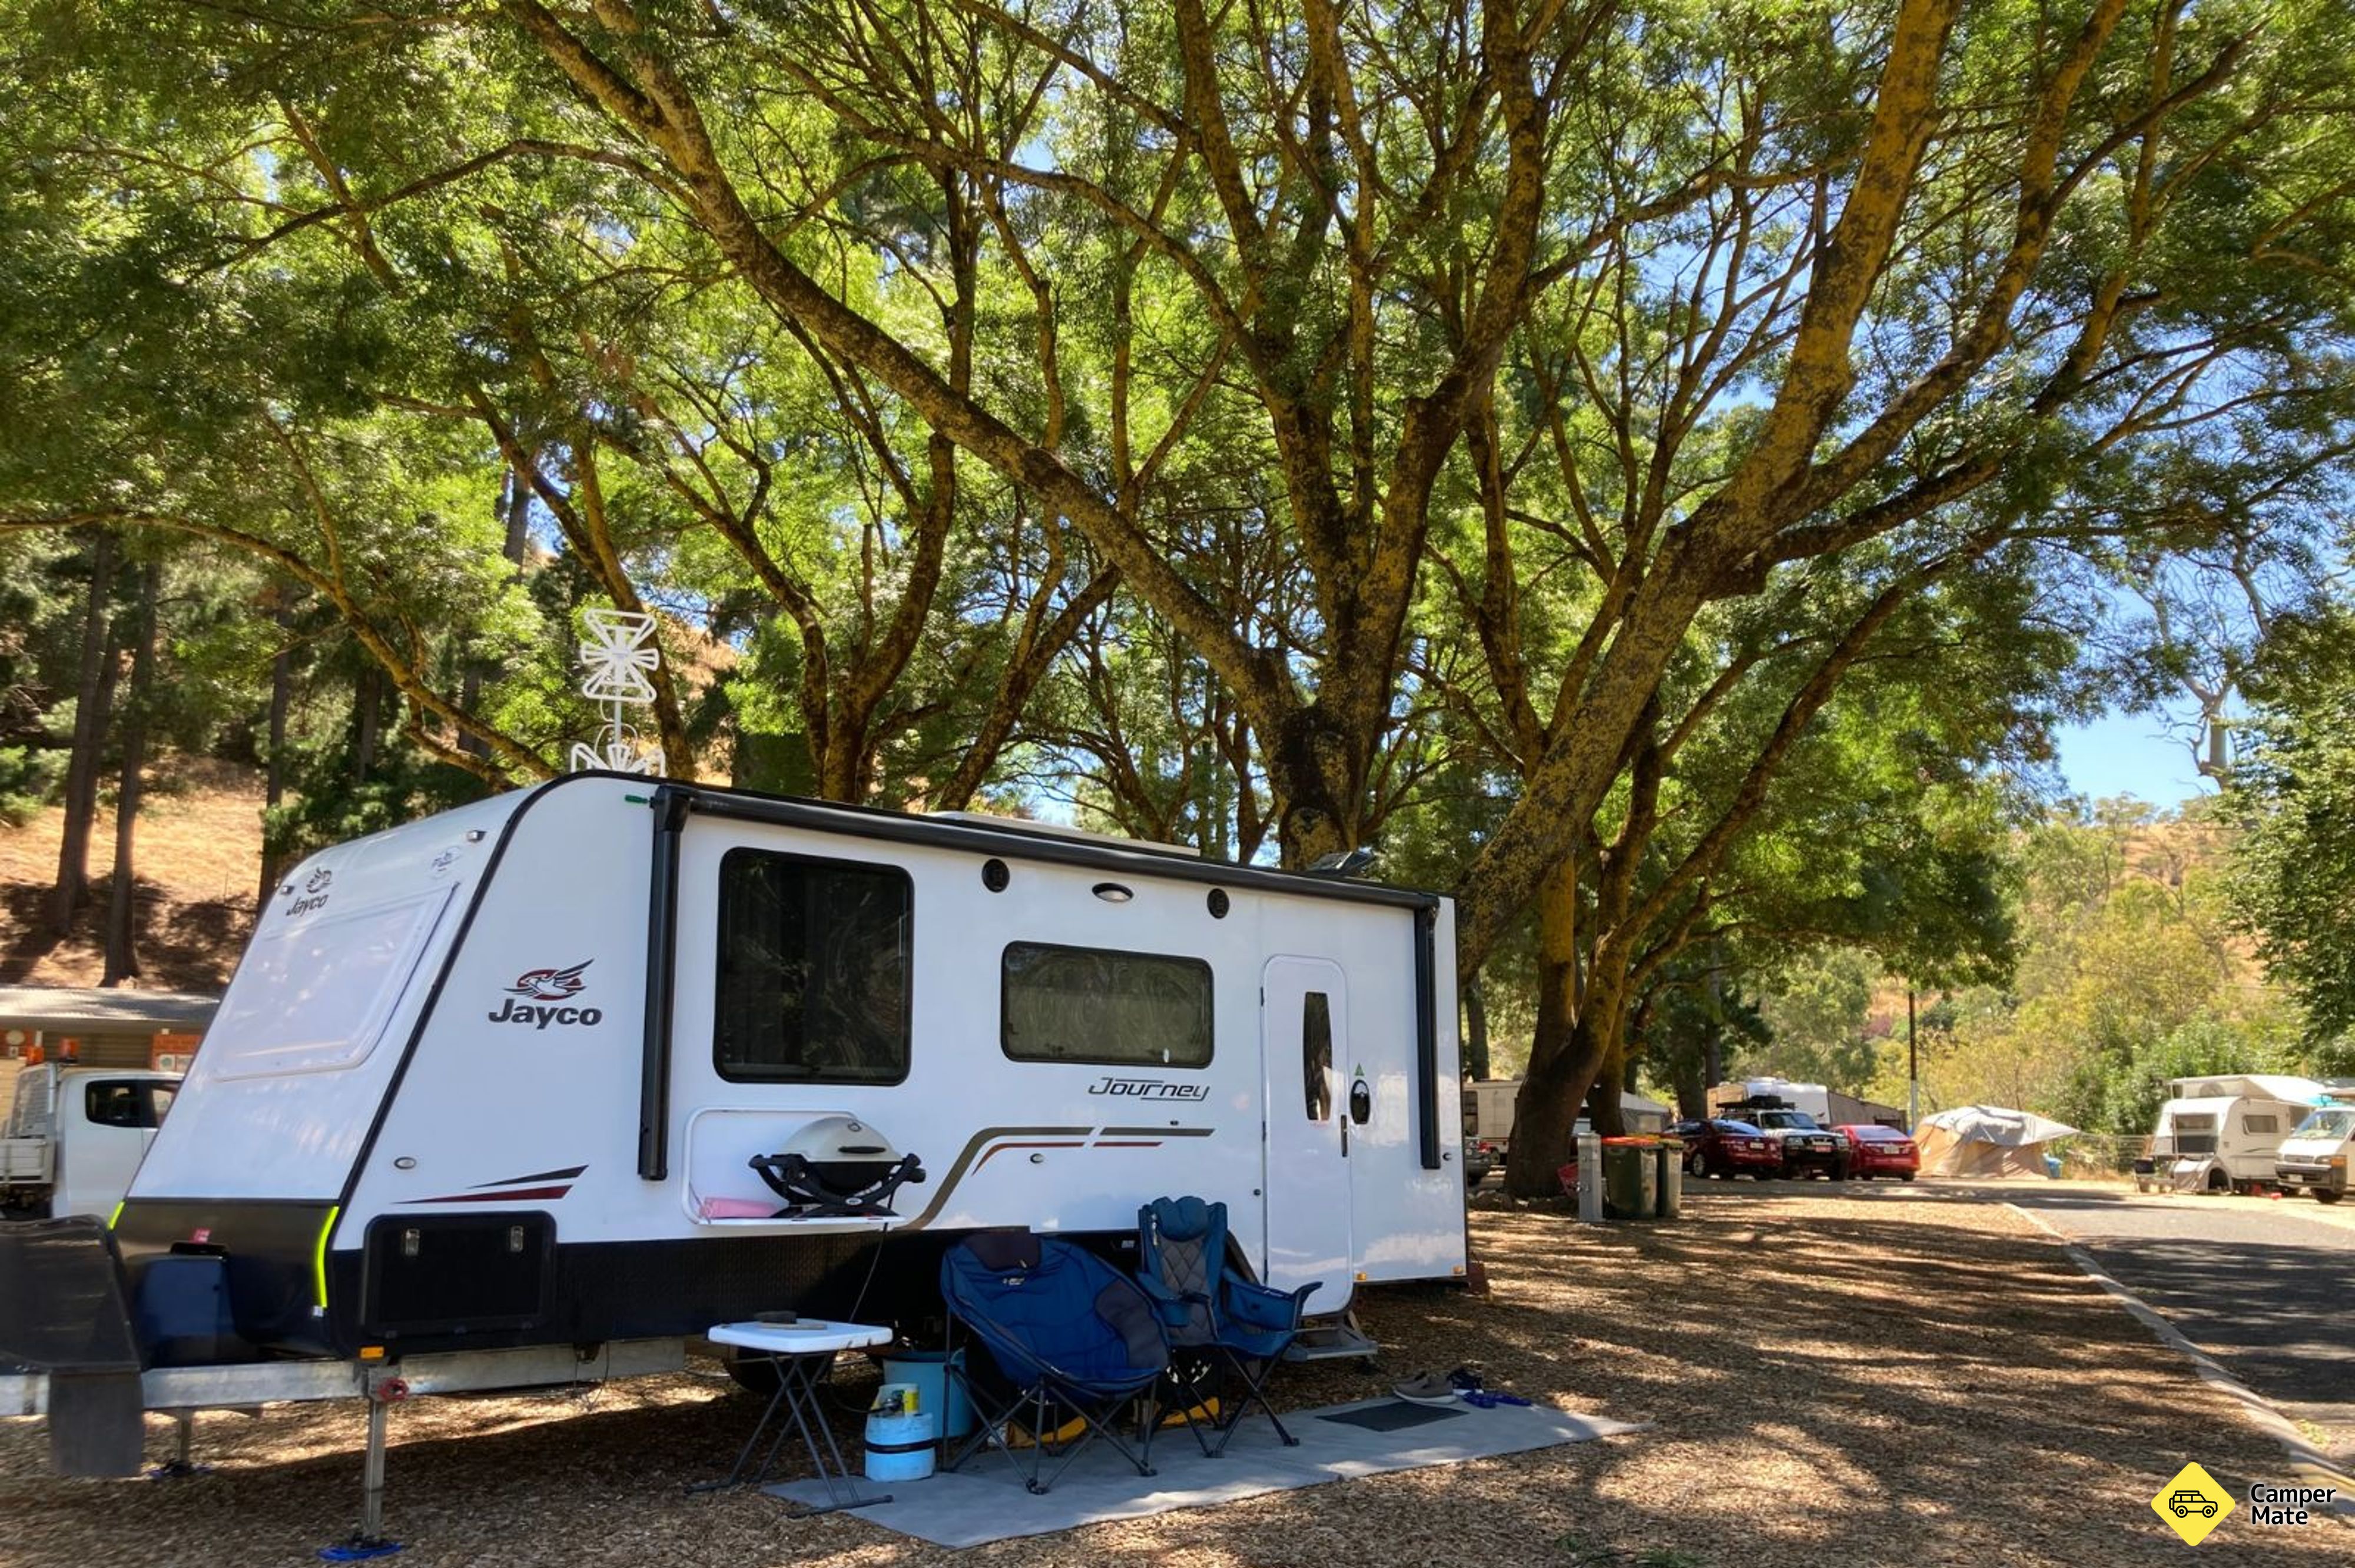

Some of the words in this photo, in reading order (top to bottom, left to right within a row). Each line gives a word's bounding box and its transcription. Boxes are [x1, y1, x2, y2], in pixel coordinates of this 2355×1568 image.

[286, 894, 329, 917] Jayco
[488, 998, 602, 1029] Jayco
[1088, 1077, 1210, 1101] Journey
